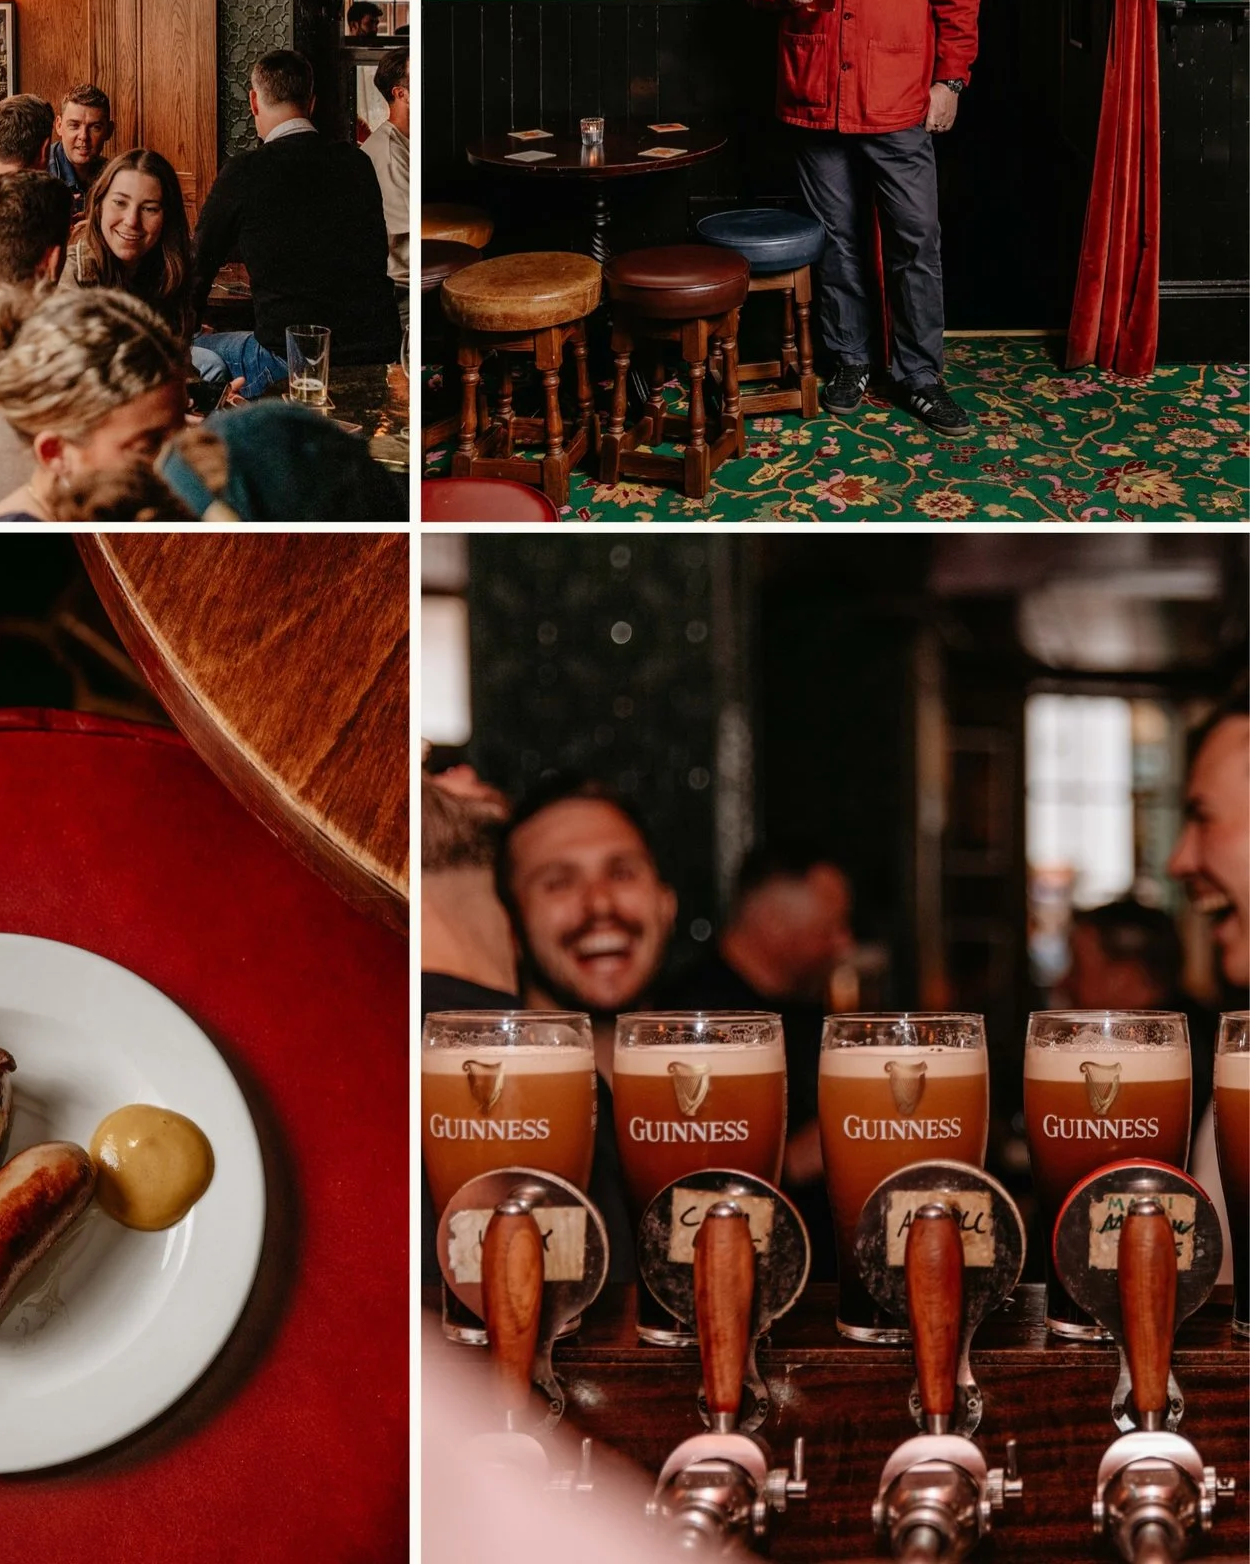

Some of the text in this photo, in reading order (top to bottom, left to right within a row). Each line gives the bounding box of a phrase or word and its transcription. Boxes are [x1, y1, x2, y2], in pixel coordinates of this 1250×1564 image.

[429, 1113, 550, 1140] GUINNESS
[628, 1116, 749, 1142] GUINNESS
[843, 1114, 962, 1141] GUINNESS
[1042, 1113, 1159, 1140] GUINNESS
